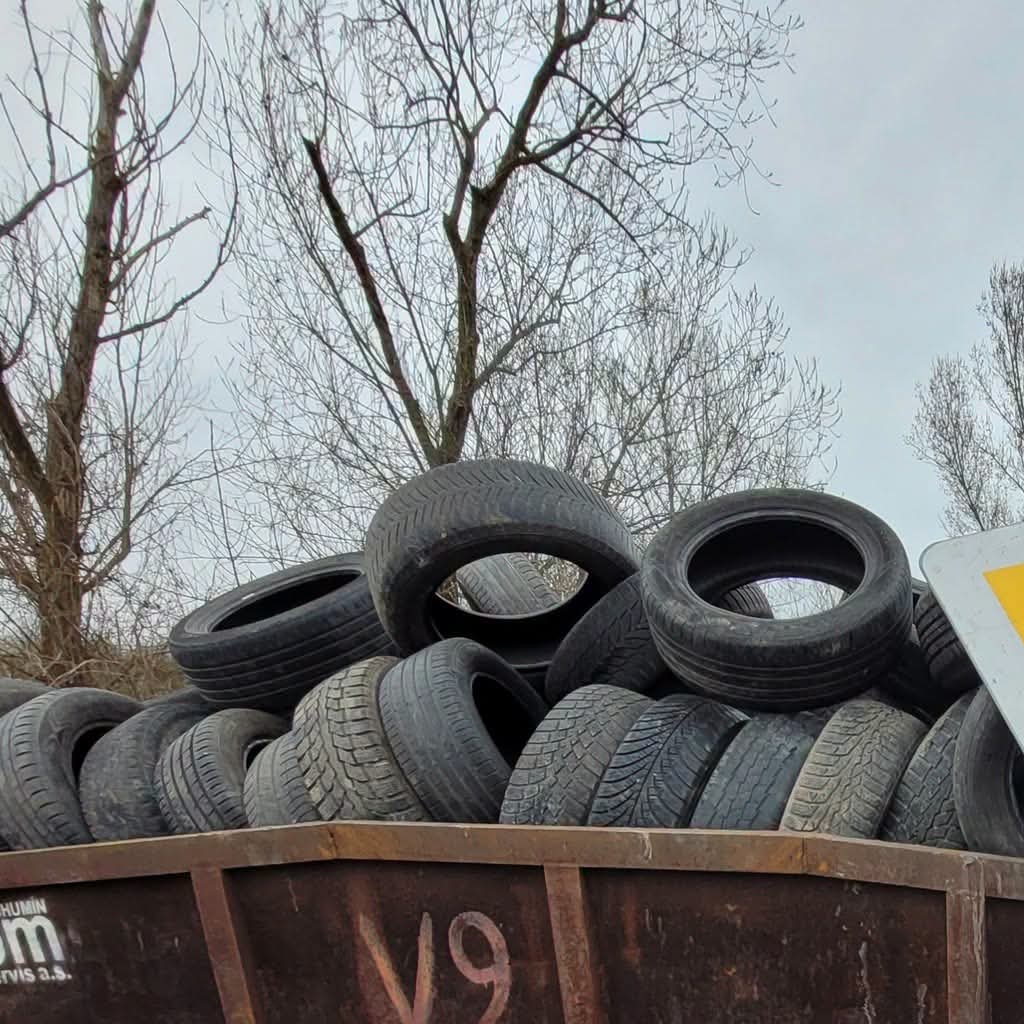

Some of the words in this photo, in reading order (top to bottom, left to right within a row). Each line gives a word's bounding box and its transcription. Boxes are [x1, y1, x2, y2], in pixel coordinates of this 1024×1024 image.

[0, 896, 48, 918] HUMÍN
[0, 915, 65, 966] m
[0, 967, 36, 984] rvis
[38, 965, 73, 982] a.s.
